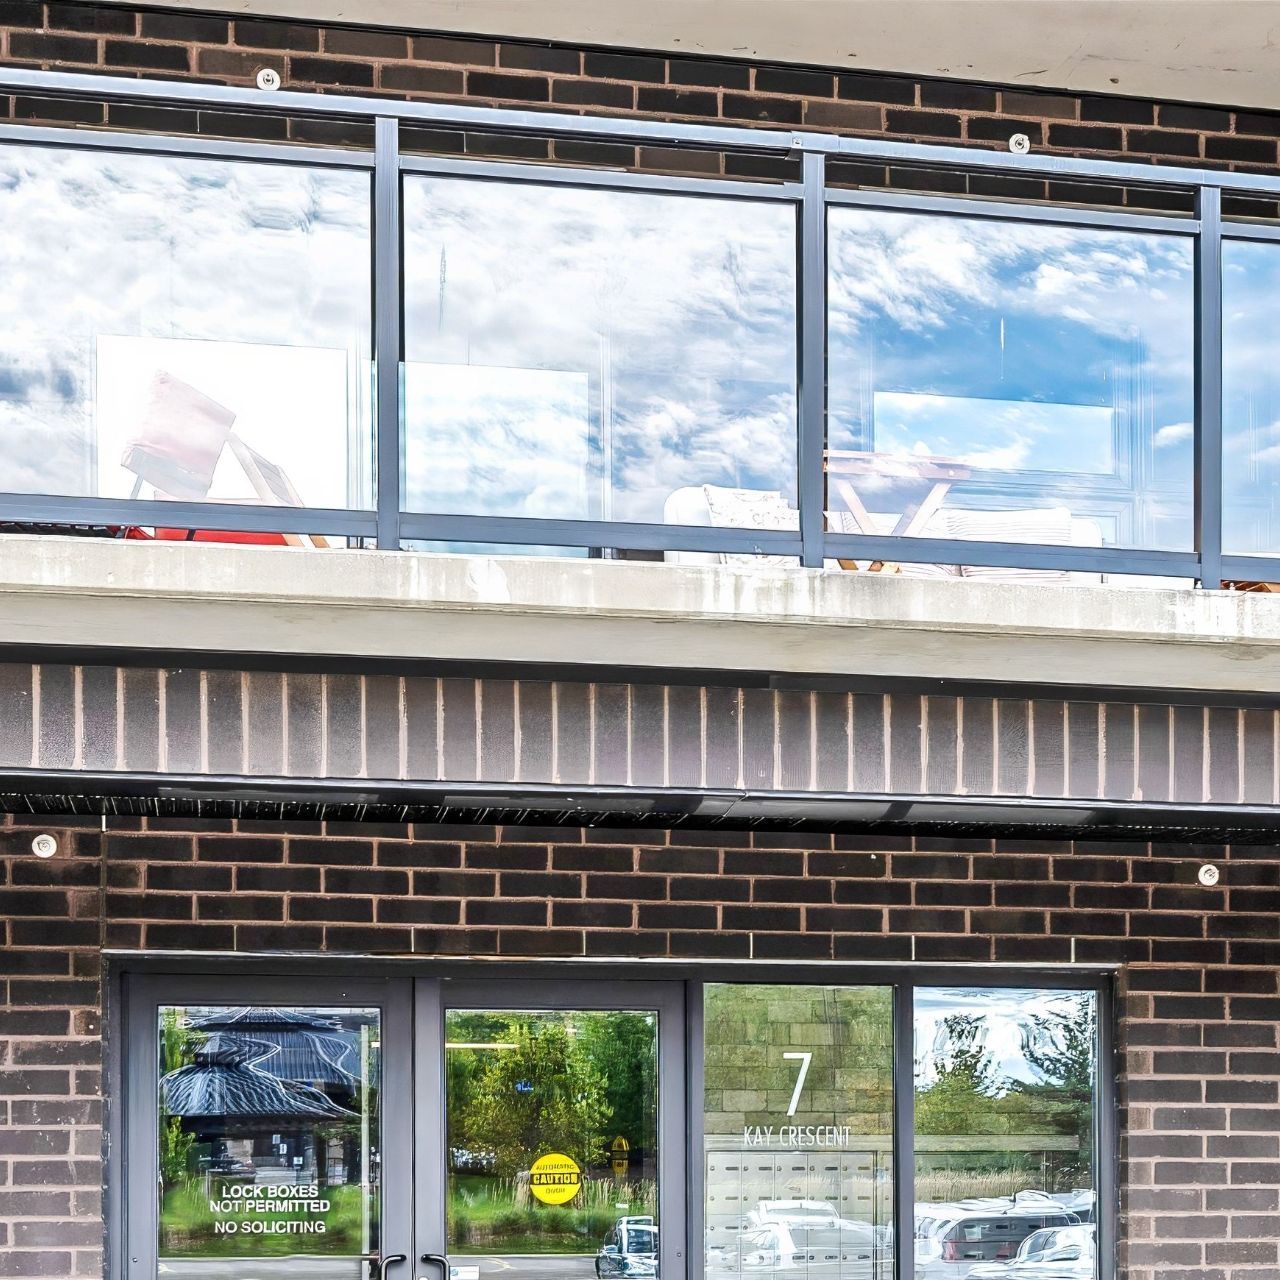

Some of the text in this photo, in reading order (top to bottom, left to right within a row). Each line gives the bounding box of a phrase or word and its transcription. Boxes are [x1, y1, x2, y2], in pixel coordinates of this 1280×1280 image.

[782, 1052, 813, 1117] 7
[743, 1125, 852, 1147] KAY CRESCENT
[533, 1173, 578, 1185] CAUTION
[222, 1185, 319, 1198] LOCK BOXES
[209, 1200, 331, 1213] NOT PERMITTED
[214, 1221, 326, 1234] NO SOLICITING
